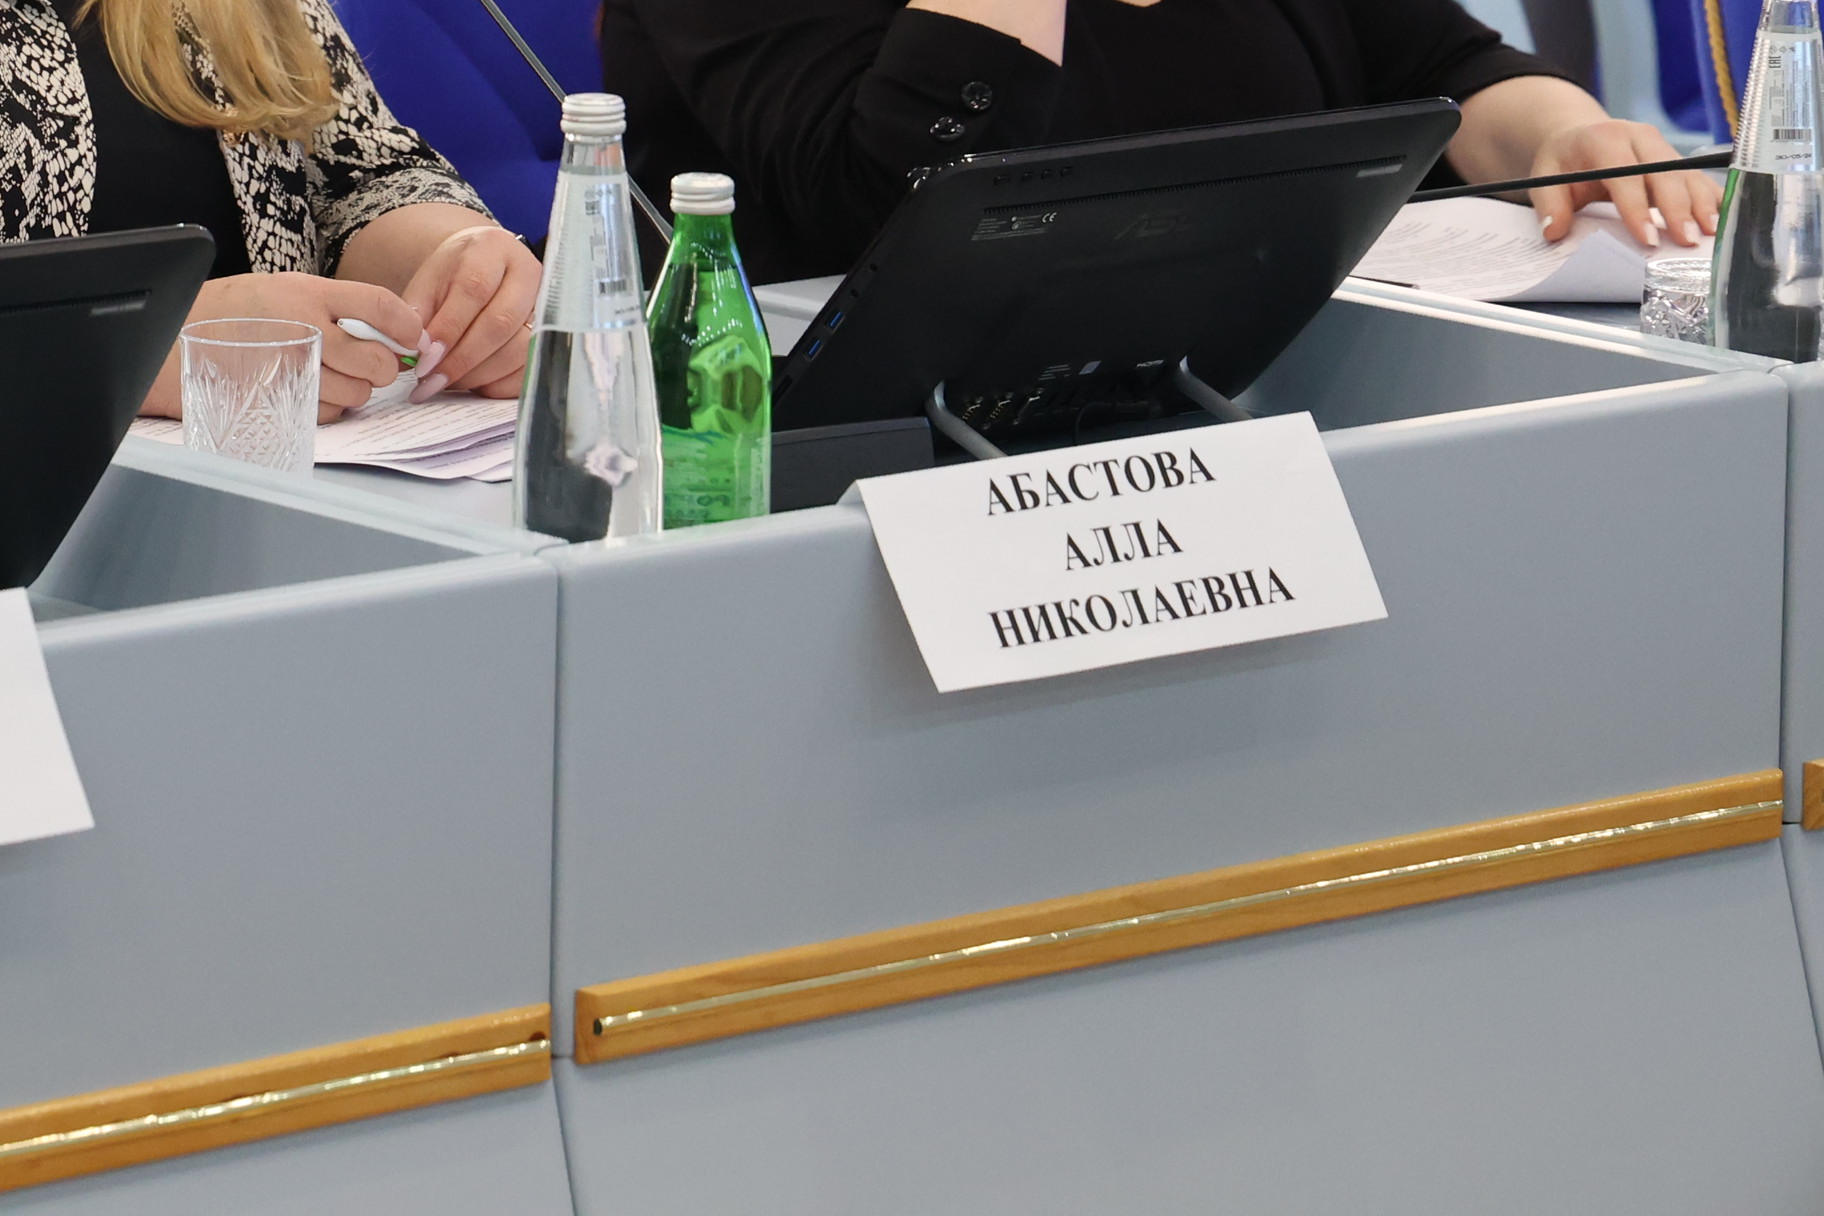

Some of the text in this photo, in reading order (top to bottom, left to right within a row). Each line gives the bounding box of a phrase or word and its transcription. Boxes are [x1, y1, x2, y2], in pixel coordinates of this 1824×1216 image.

[986, 447, 1216, 516] АБАСТОВА
[1064, 518, 1184, 571] АЛЛА
[987, 566, 1296, 648] НИКОЛАЕВНА
